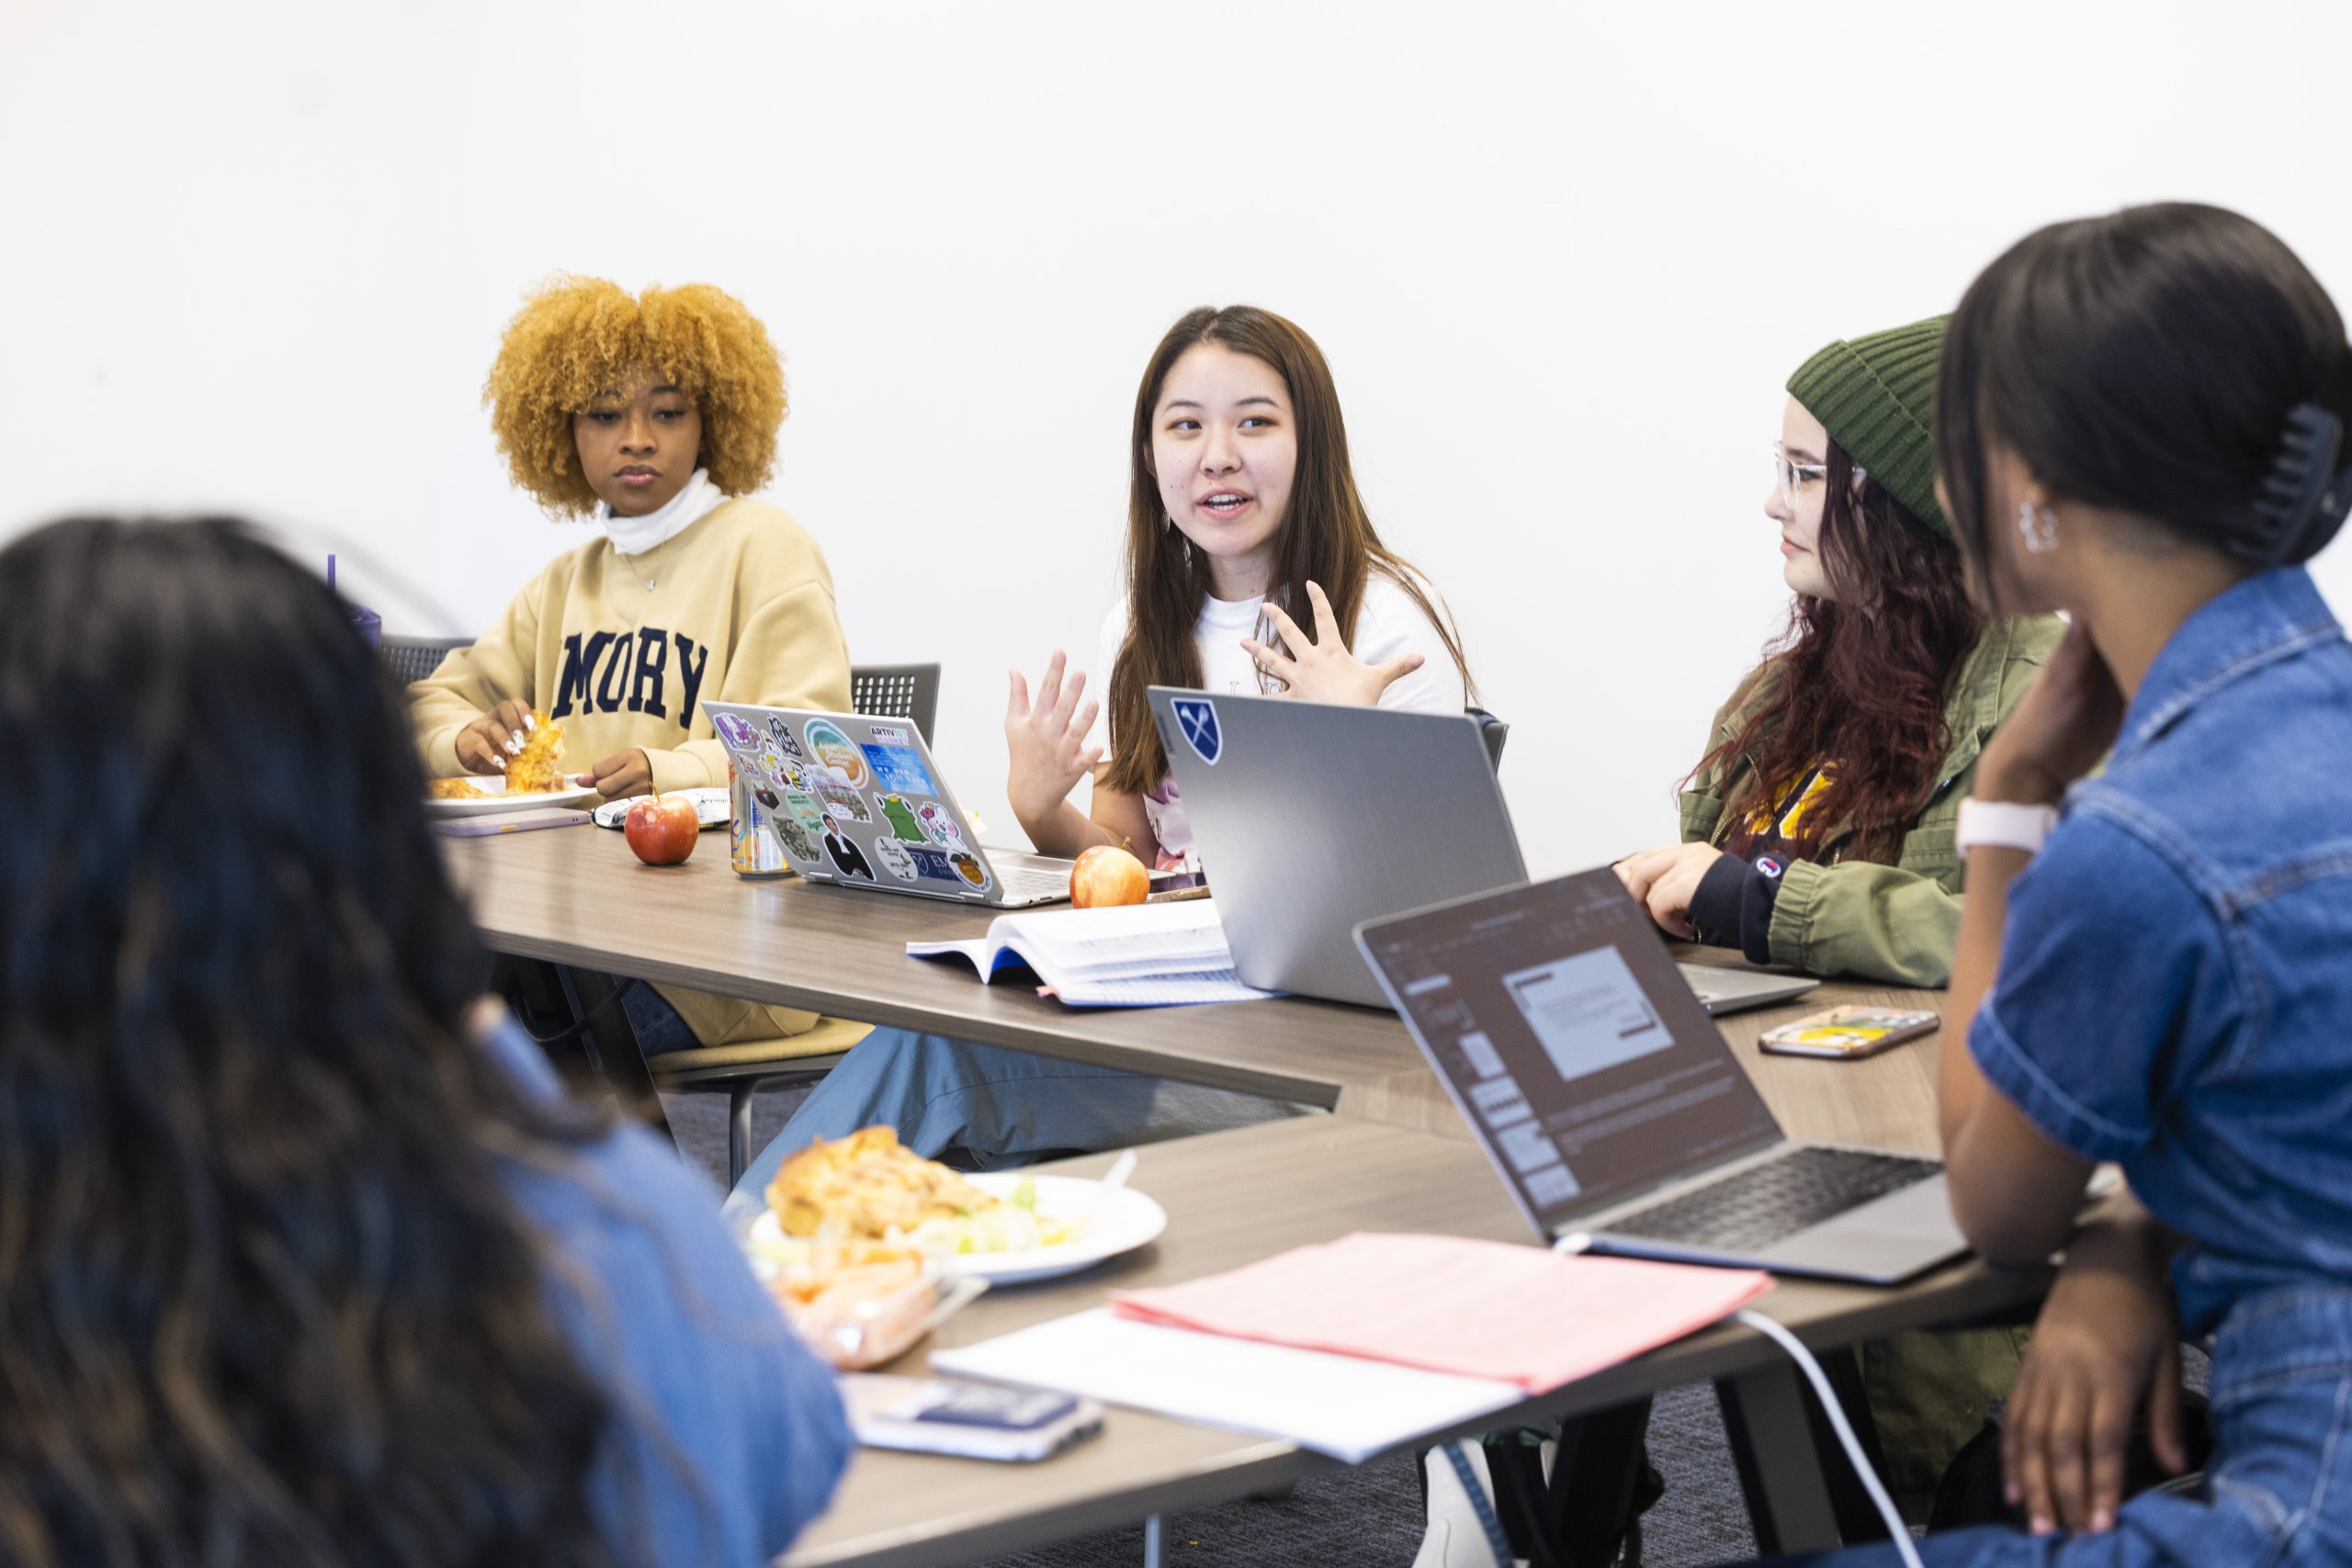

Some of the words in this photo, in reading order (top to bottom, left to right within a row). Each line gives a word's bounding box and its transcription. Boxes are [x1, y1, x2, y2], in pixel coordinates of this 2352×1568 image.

[871, 727, 908, 738] ARTIVIST
[825, 756, 850, 765] Center
[826, 750, 855, 761] Student
